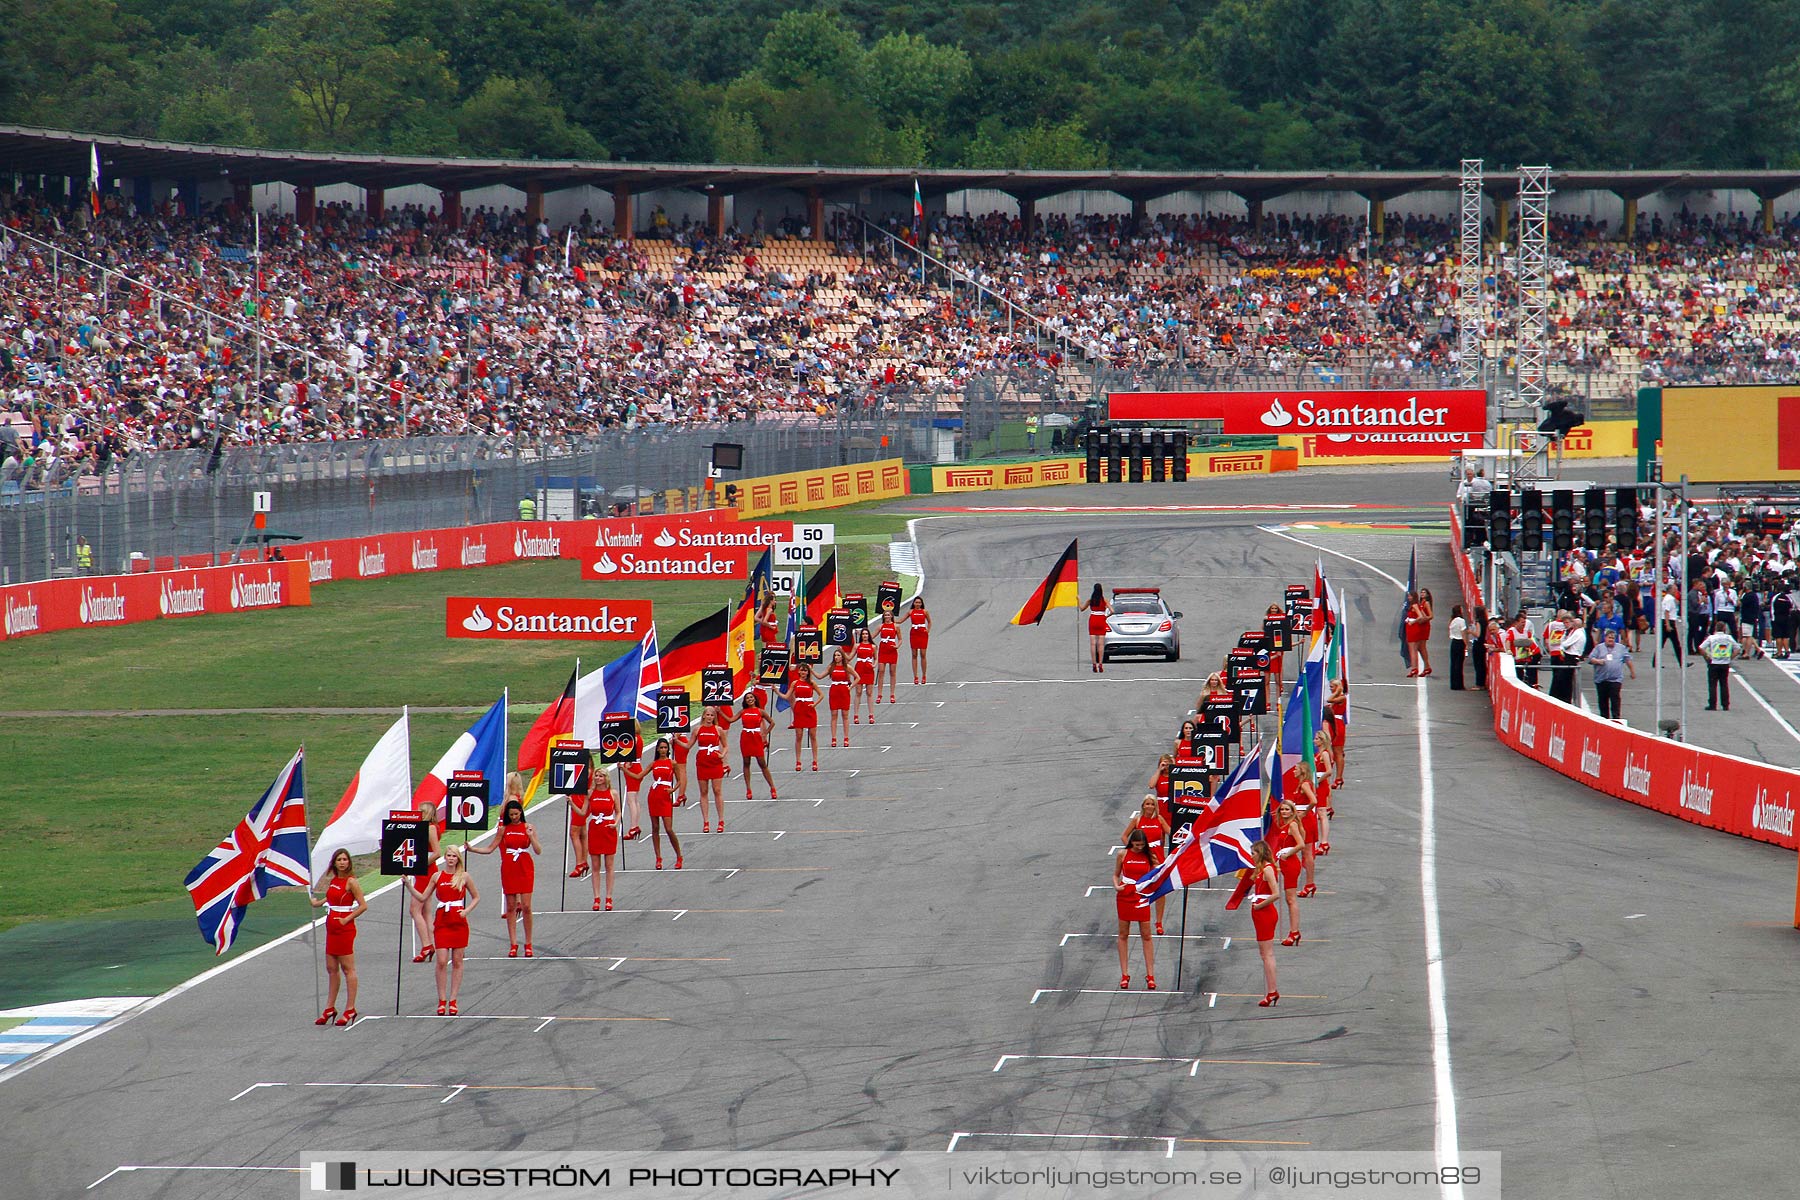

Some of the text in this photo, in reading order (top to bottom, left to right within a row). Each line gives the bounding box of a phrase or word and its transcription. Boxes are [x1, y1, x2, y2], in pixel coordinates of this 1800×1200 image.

[1297, 397, 1448, 427] Santander
[1041, 463, 1069, 480] PIRELLI
[1209, 454, 1263, 473] PIRELLI
[946, 470, 993, 487] PIRELLI
[1005, 467, 1032, 484] PIRELLI
[259, 495, 265, 509] 1
[522, 528, 561, 558] Santander
[604, 523, 643, 547] Santander
[679, 526, 783, 547] Santander
[803, 529, 823, 541] 50
[620, 552, 735, 575] Santander
[782, 547, 813, 560] 100
[167, 573, 205, 615] Santander
[239, 568, 281, 608] Santander
[10, 590, 38, 635] Santander
[87, 582, 125, 623] Santander
[882, 596, 895, 612] 6
[497, 605, 638, 634] Santander
[833, 624, 847, 642] 3
[799, 641, 820, 660] 14
[761, 659, 789, 679] 27
[704, 680, 733, 701] 22
[1241, 689, 1258, 710] 7
[659, 705, 689, 728] 25
[602, 733, 635, 758] 99
[1197, 745, 1225, 770] 21
[554, 763, 585, 789] 17
[1628, 752, 1651, 796] Santander
[1174, 781, 1204, 803] 13
[1685, 769, 1714, 815] Santander
[451, 795, 484, 824] 10
[1759, 789, 1795, 836] Santander
[393, 838, 416, 868] 4
